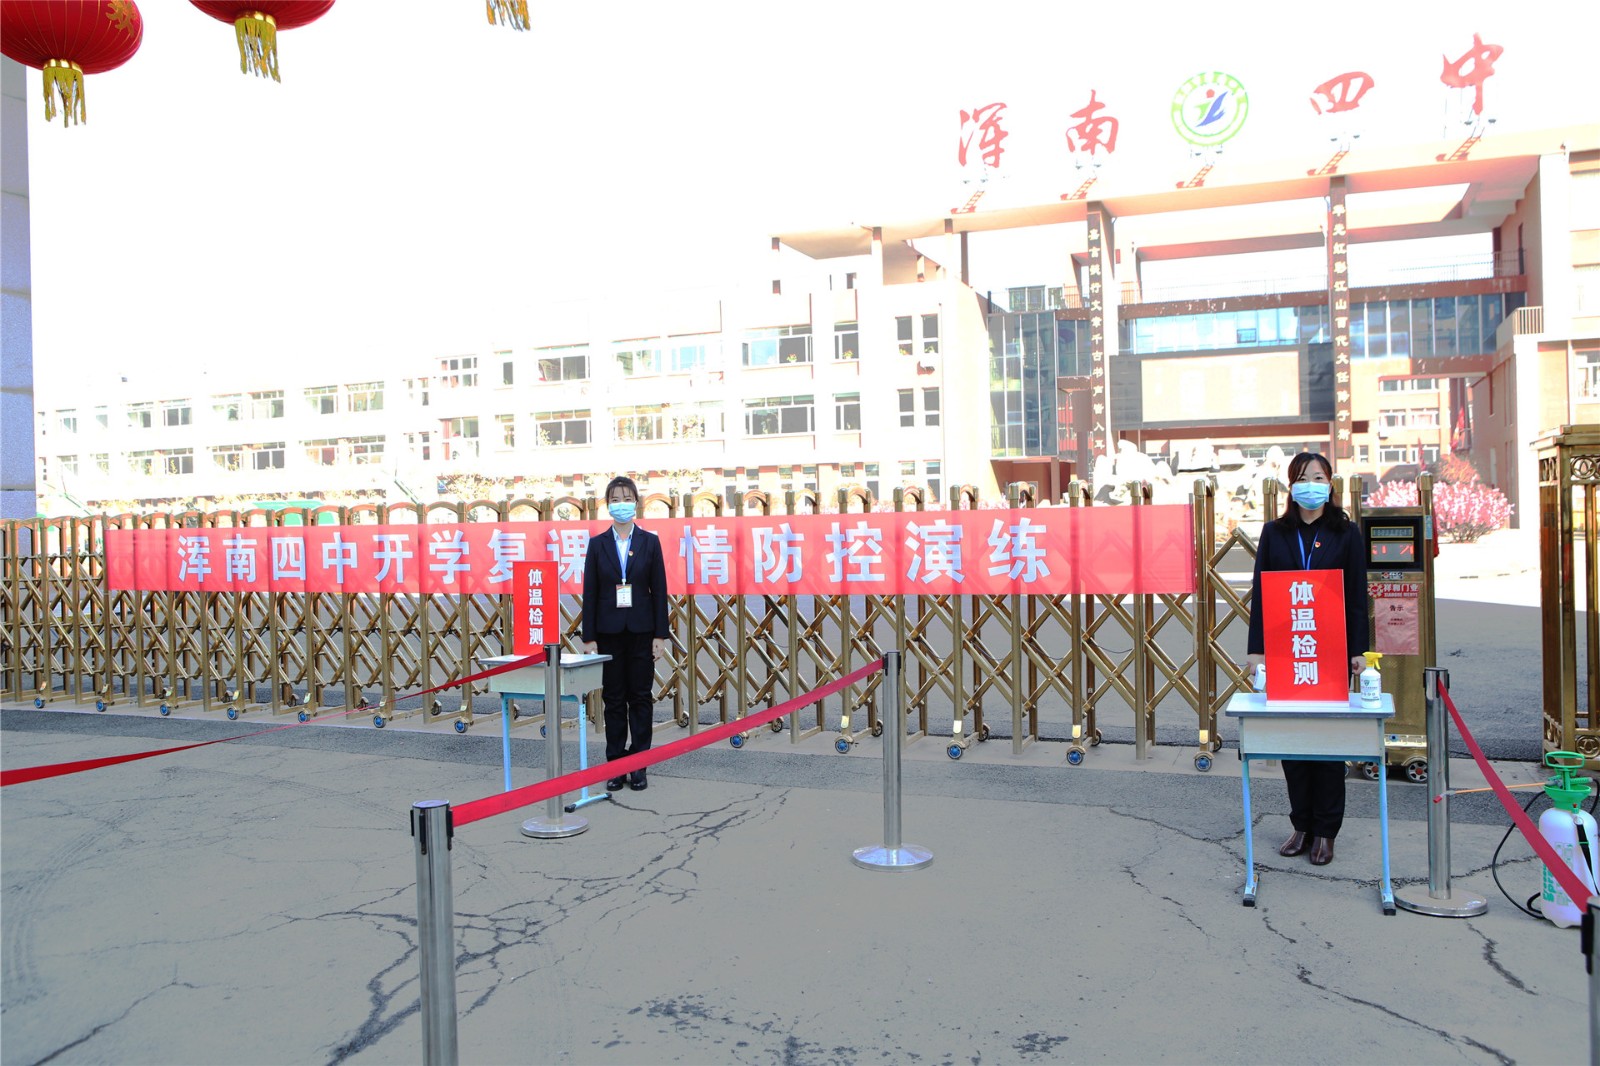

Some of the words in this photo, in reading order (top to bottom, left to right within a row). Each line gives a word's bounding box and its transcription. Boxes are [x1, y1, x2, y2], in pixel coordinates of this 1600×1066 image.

[177, 510, 1051, 586] 浑南四中开学复课情防控演练
[528, 568, 545, 646] 体温检测
[1288, 580, 1320, 686] 体温检测
